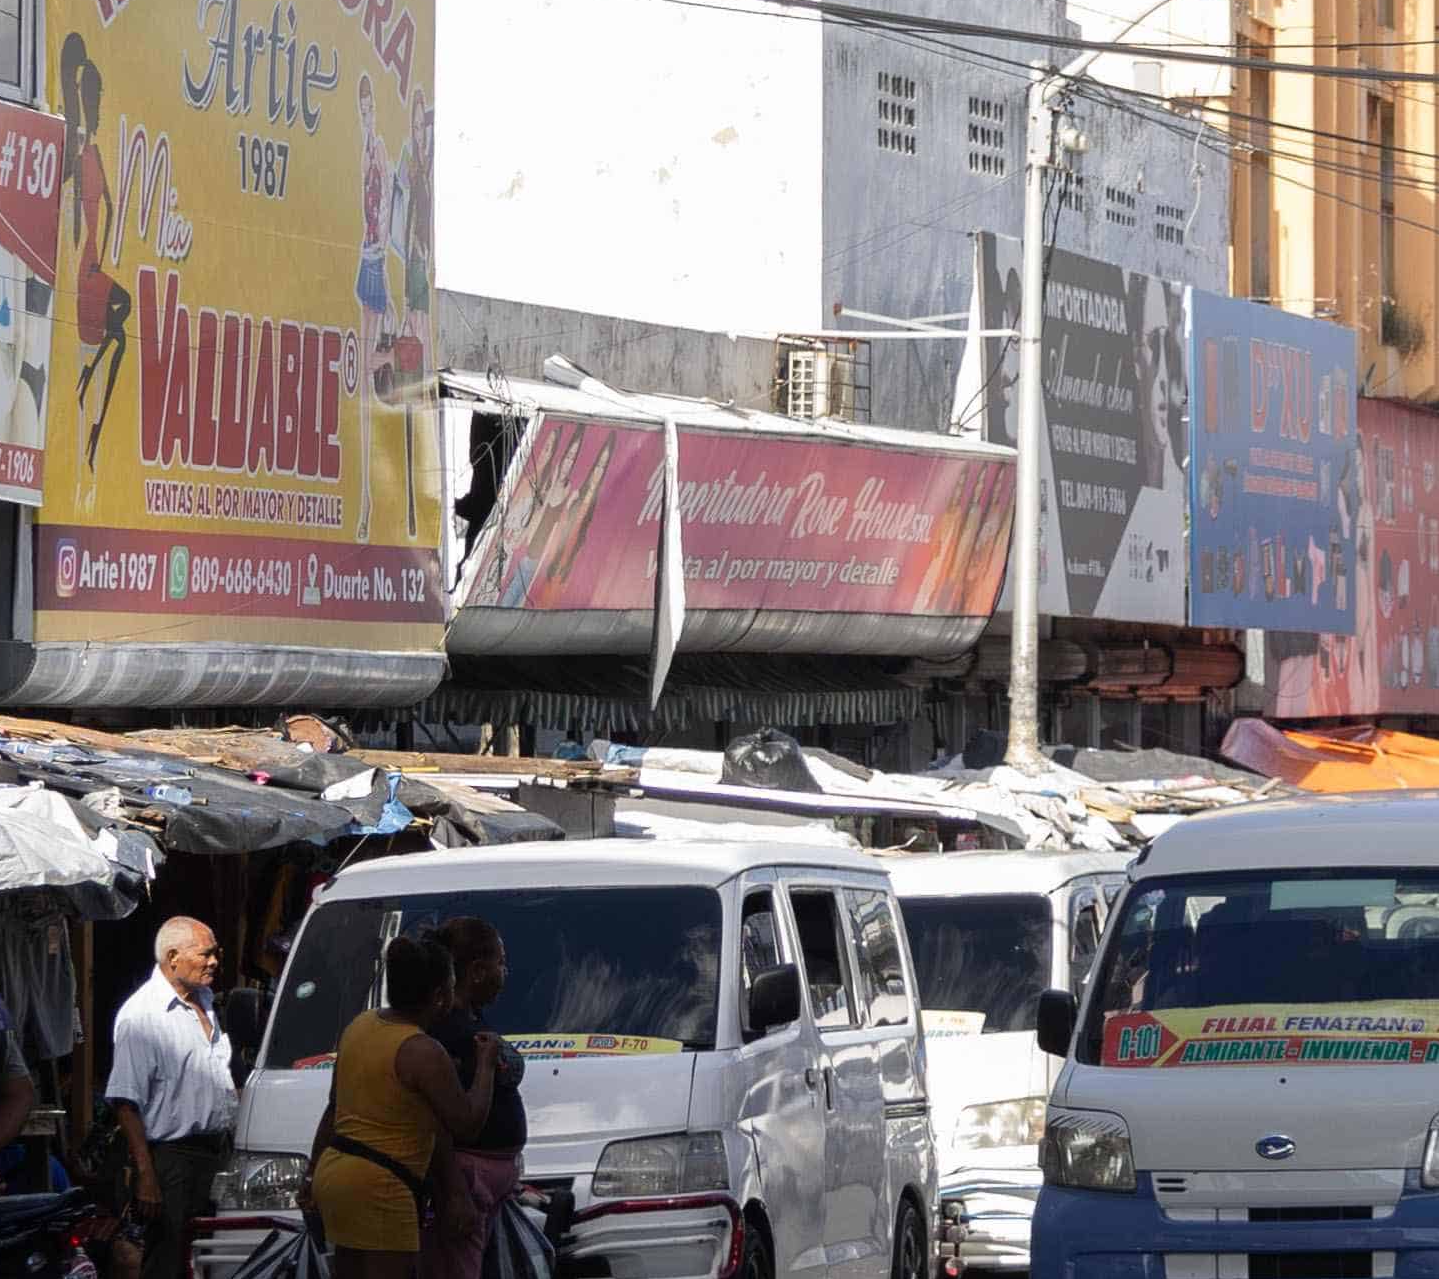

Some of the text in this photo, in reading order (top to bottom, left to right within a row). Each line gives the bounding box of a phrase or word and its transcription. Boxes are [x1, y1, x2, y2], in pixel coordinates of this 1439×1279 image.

[0, 130, 58, 199] #130
[236, 132, 290, 200] 1987
[138, 266, 342, 482] VALUABLE
[145, 482, 342, 525] VENTAS AL POR MAYOR Y DETALLE
[637, 463, 794, 527] Iportadora
[791, 472, 848, 539] Rose
[846, 476, 915, 543] House
[80, 551, 425, 602] Artie1987 809-668-6430 Duarte No. 132
[646, 549, 899, 588] Vta al por mayor y detalle
[621, 1037, 648, 1051] F-70
[1118, 1023, 1162, 1061] R-101
[1201, 1017, 1277, 1034] FILIAL
[1180, 1040, 1290, 1064] ALMIRANTE
[1299, 1039, 1410, 1062] INVIVIENDA
